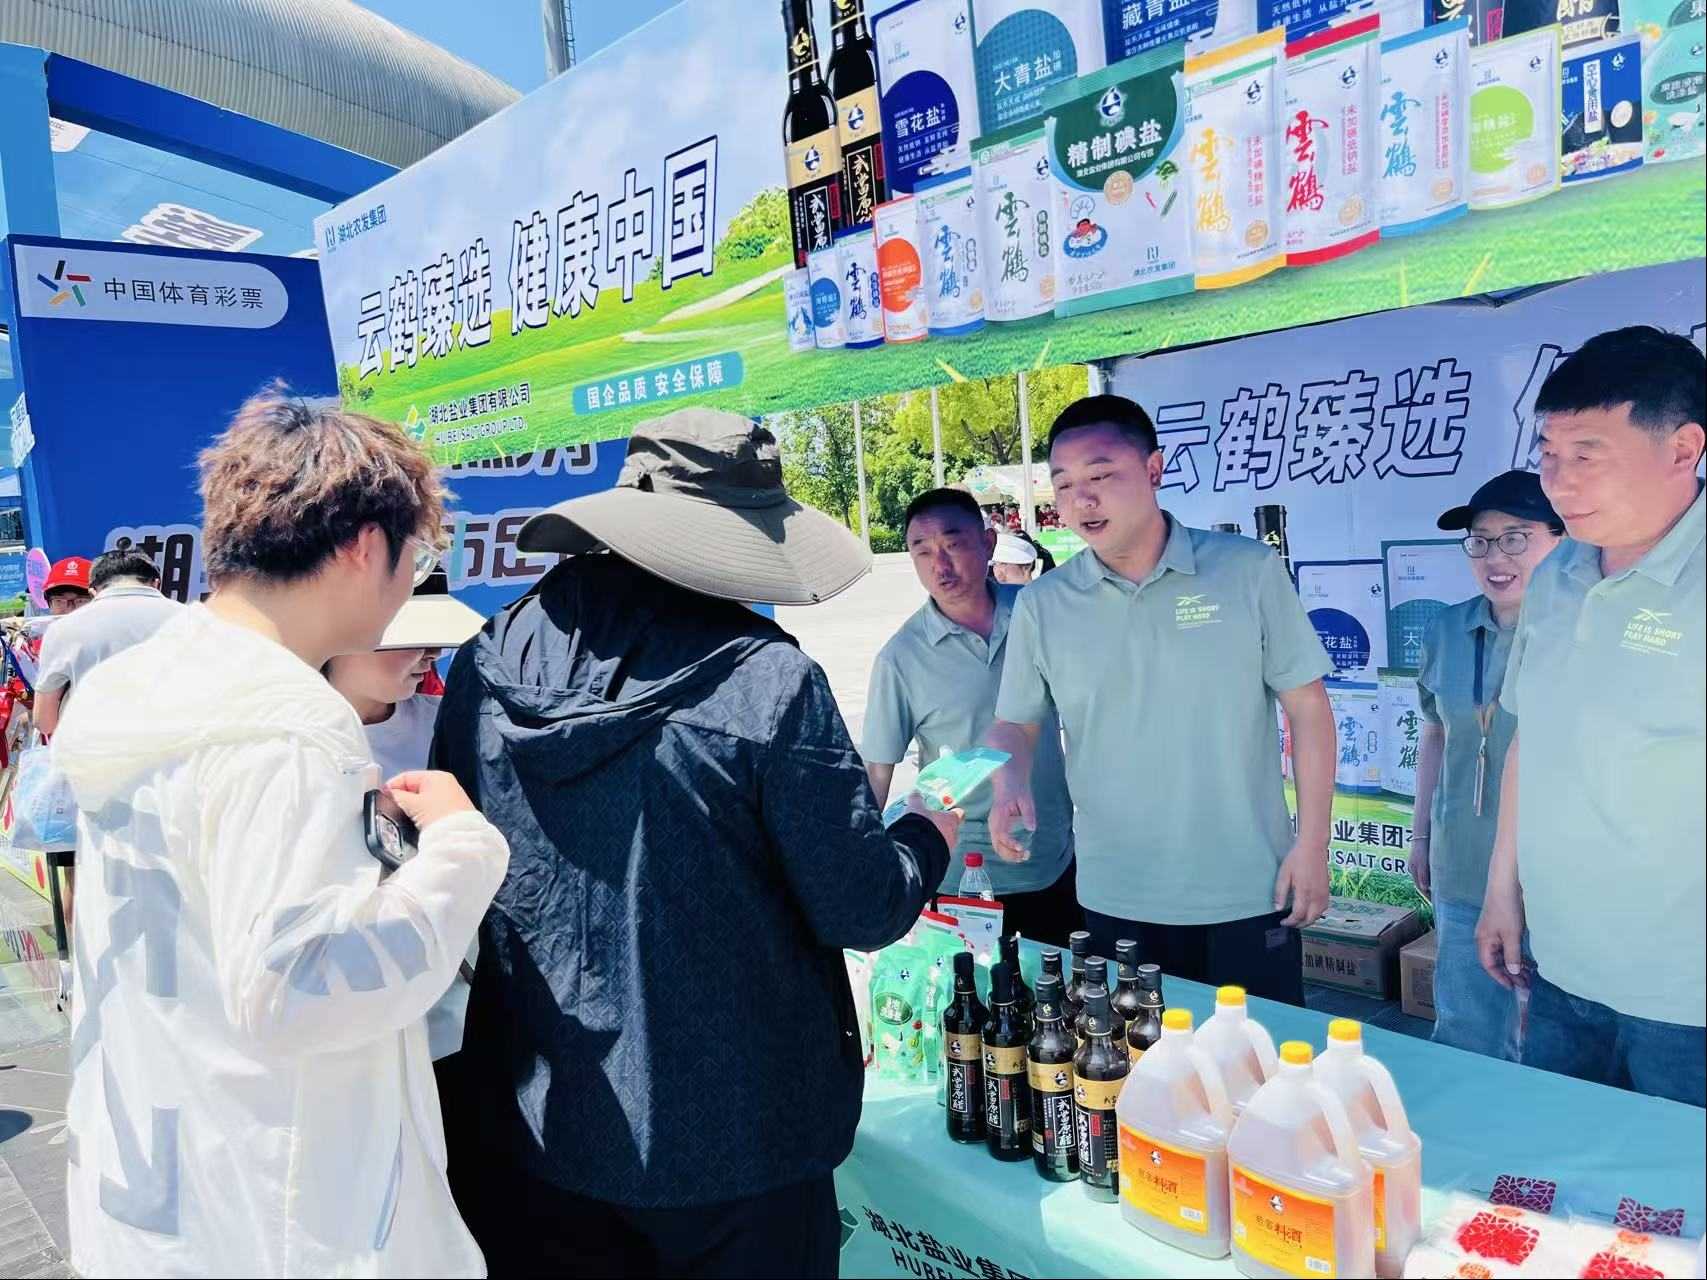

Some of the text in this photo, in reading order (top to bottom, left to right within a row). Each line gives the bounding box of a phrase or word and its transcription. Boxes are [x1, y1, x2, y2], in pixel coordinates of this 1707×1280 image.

[994, 53, 1052, 96] 大青盐
[895, 106, 941, 138] 雪花盐
[1066, 118, 1162, 169] 精制碘盐
[337, 204, 387, 246] 湖北农发集团
[358, 134, 718, 381] 云鹤臻选 健康中国
[104, 277, 264, 309] 中国体育彩票
[429, 383, 530, 424] 湖北盐业集团有限公司
[587, 360, 724, 410] 国企品质 安全保障
[1155, 357, 1472, 494] 云鹤臻选
[1335, 850, 1410, 874] SALT GR
